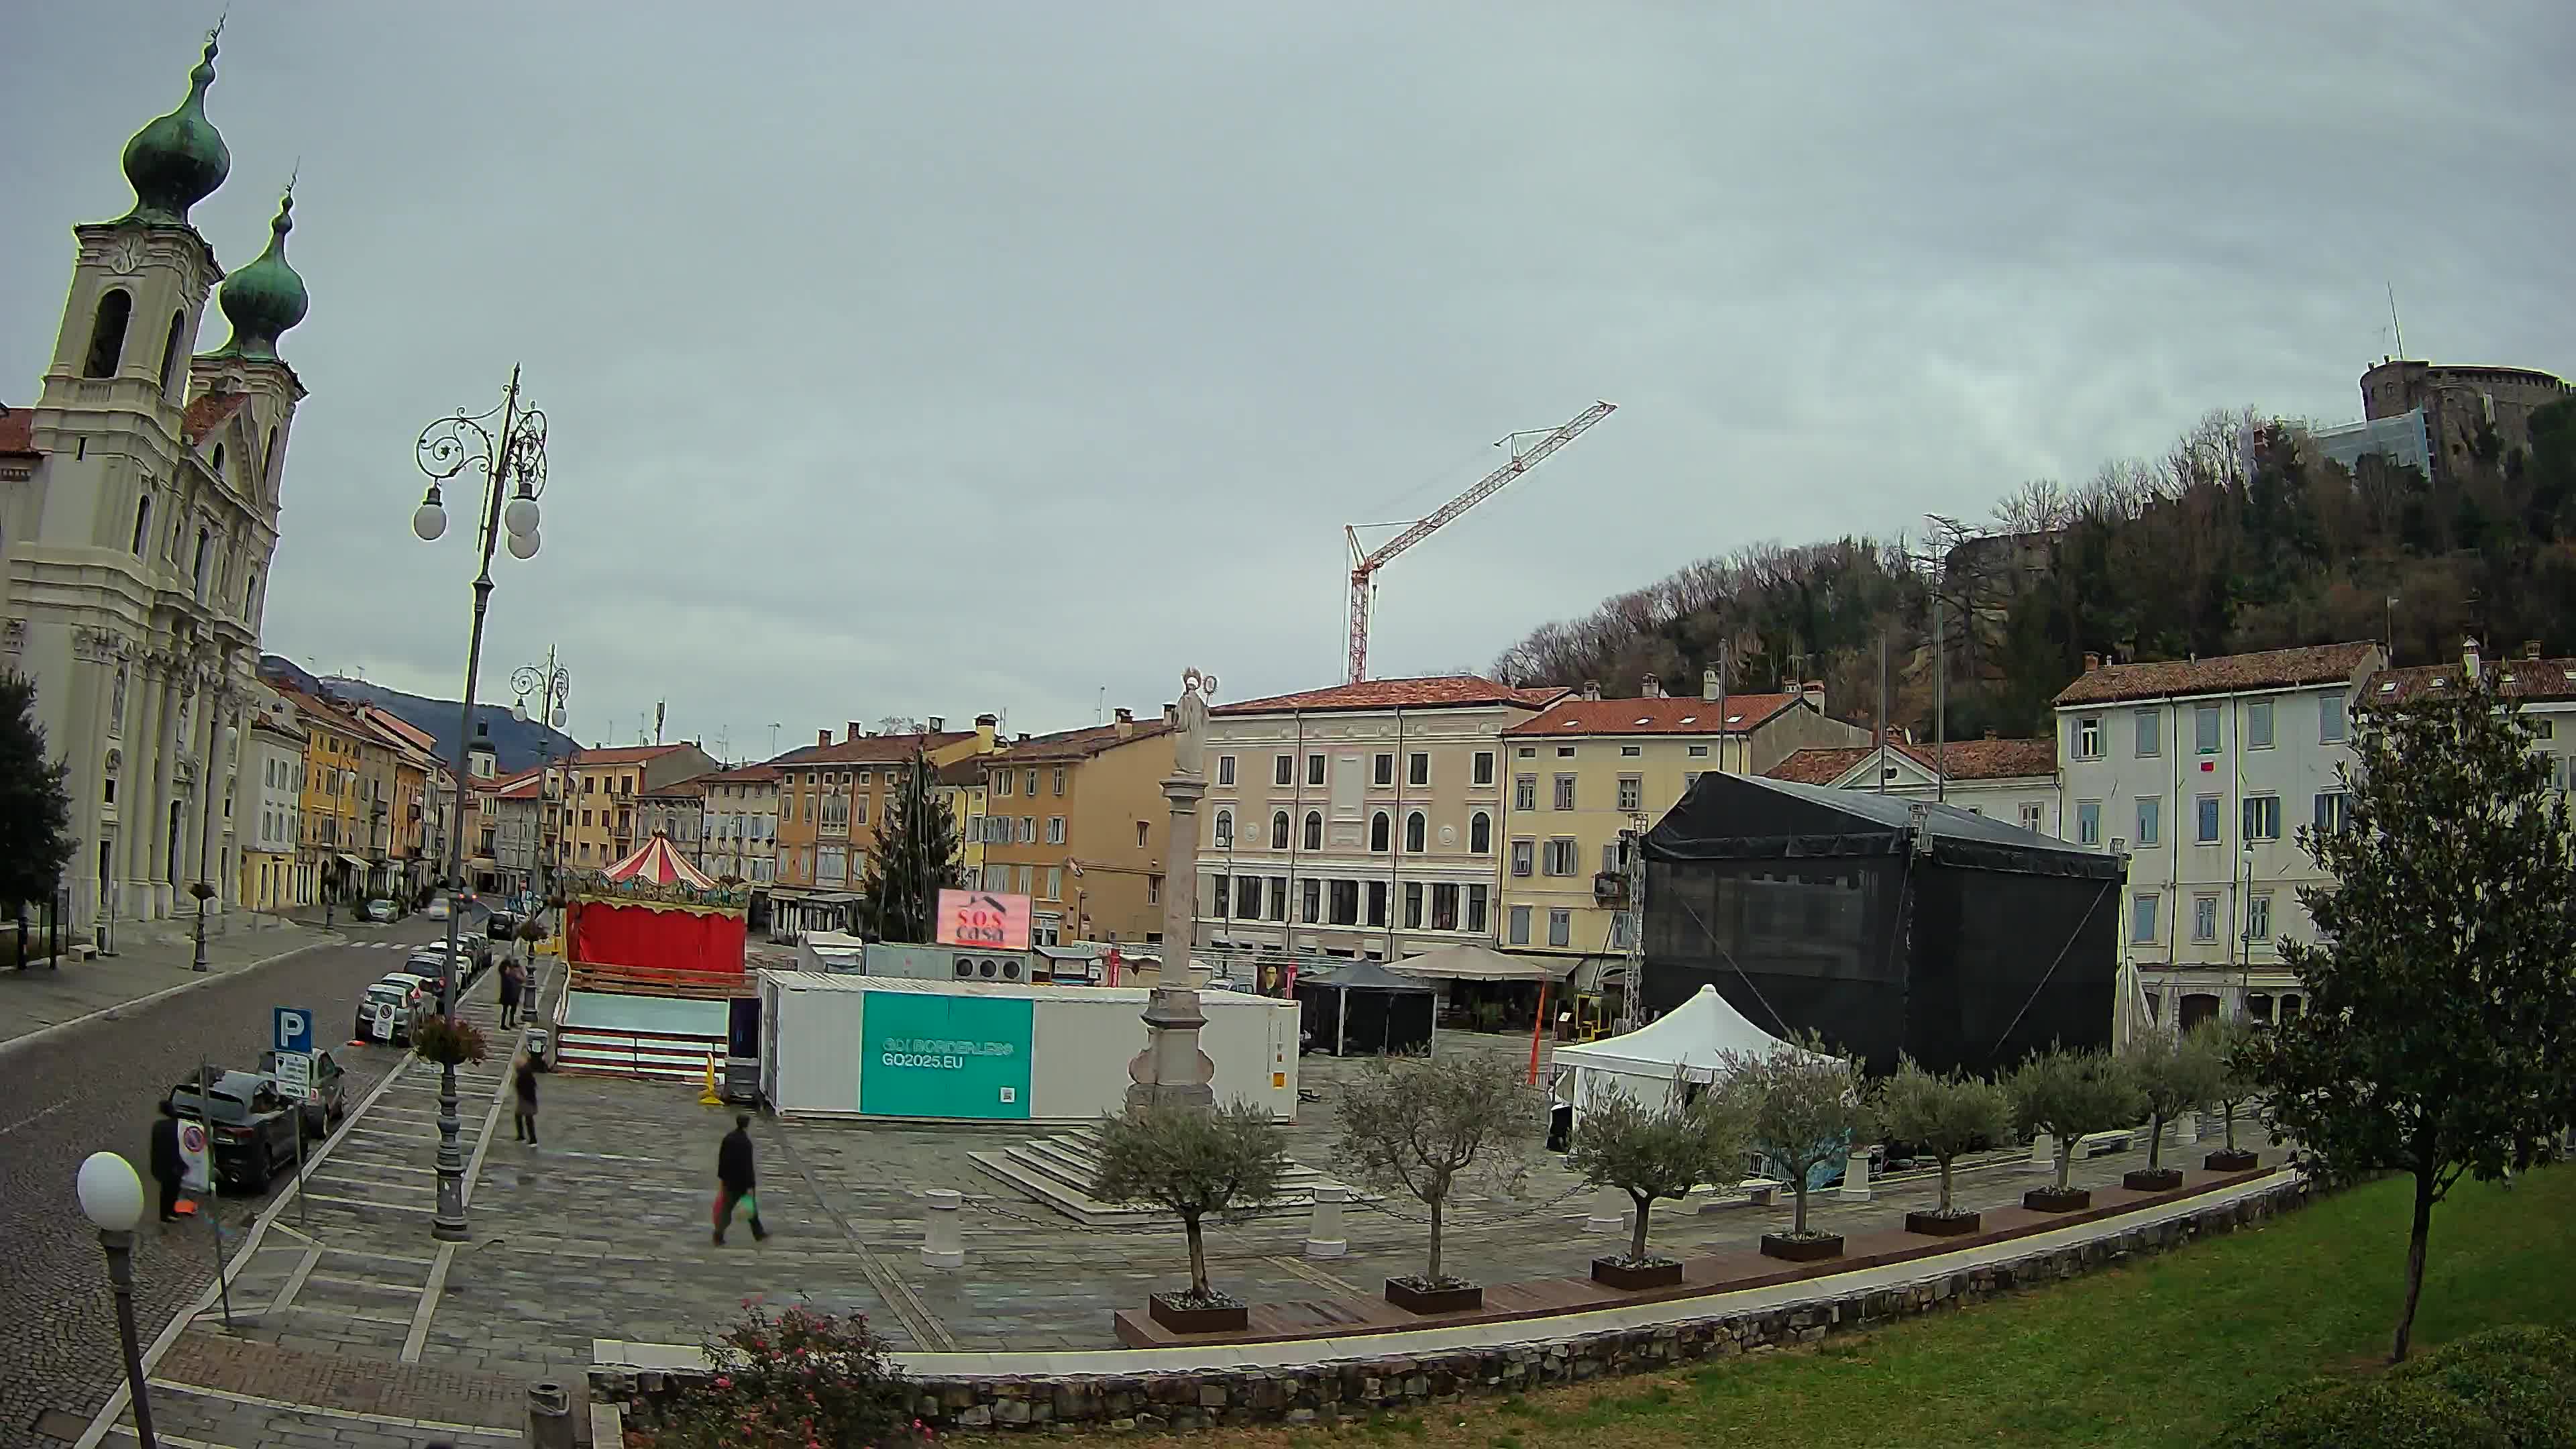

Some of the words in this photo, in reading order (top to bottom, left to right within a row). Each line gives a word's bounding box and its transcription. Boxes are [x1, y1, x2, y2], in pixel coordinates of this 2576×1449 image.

[280, 1011, 305, 1046] P
[912, 1039, 1014, 1056] BORDERLESS
[882, 1053, 963, 1069] GO2025.EU
